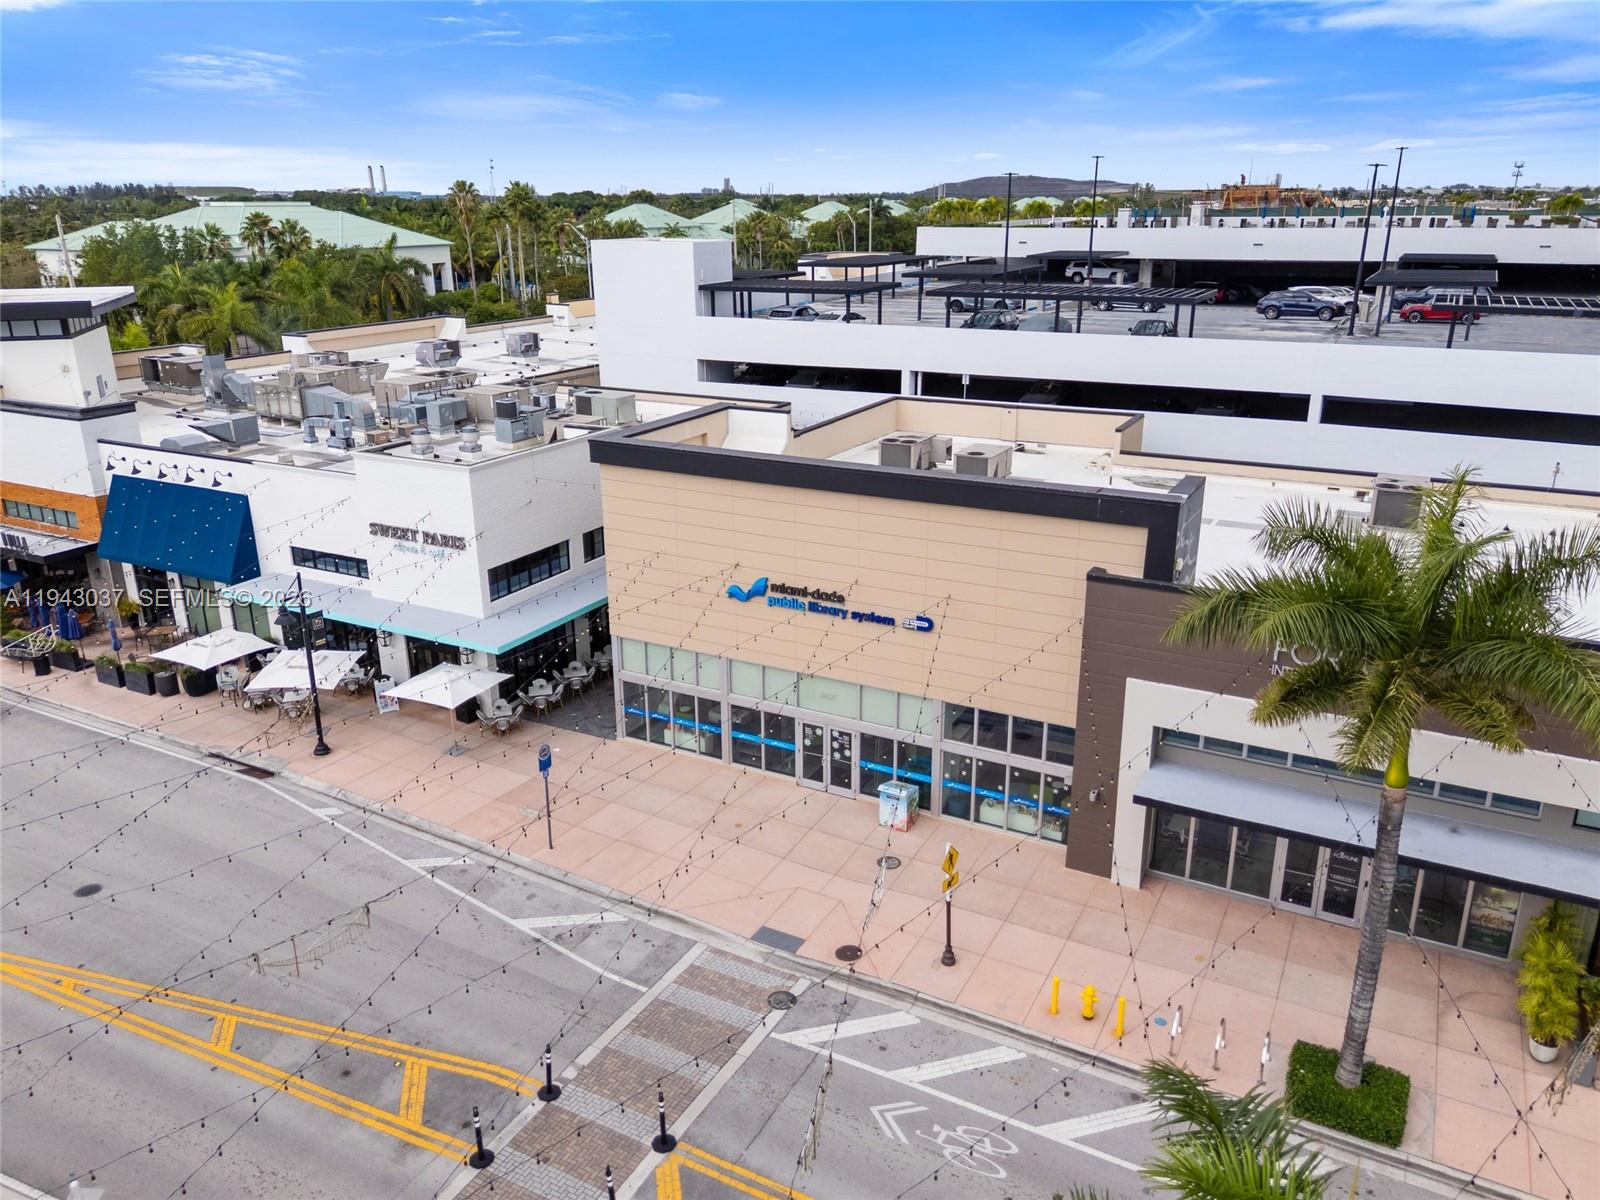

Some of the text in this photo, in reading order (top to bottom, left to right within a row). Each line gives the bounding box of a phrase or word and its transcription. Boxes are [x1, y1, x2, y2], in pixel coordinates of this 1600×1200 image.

[369, 522, 467, 551] SWEET PARIS
[770, 582, 845, 604] miami-dade
[767, 595, 806, 612] public
[808, 601, 848, 619] library
[851, 611, 895, 627] system
